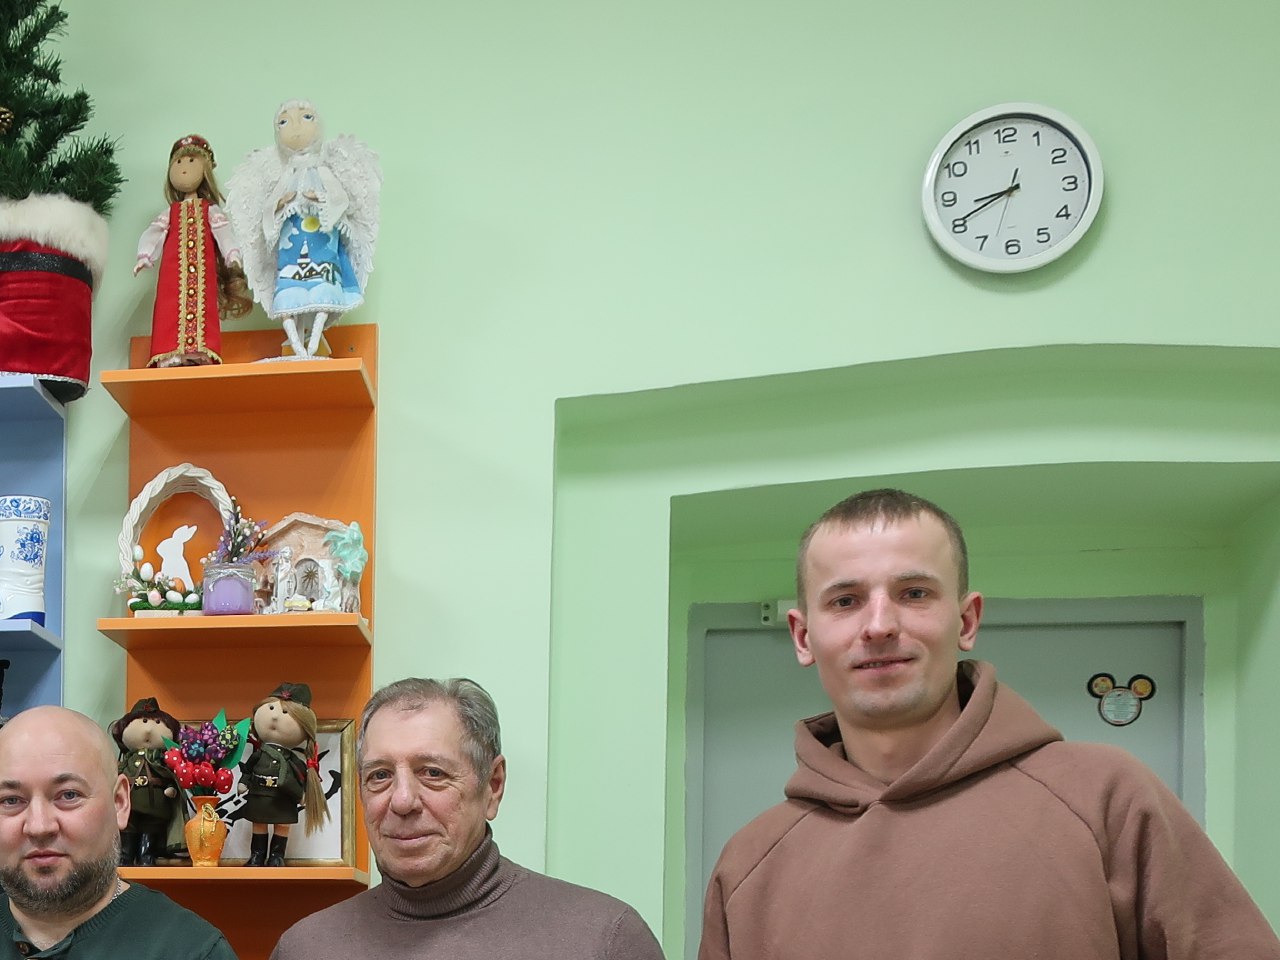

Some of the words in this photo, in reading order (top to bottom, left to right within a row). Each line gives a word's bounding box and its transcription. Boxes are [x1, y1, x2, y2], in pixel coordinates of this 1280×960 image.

[993, 126, 1018, 144] 12
[1032, 130, 1041, 147] 1
[964, 139, 980, 155] 11
[1050, 147, 1068, 165] 2
[943, 161, 968, 178] 10
[1061, 175, 1079, 192] 3
[941, 190, 958, 208] 9
[1055, 204, 1072, 220] 4
[951, 217, 968, 234] 8
[974, 235, 989, 251] 7
[1036, 227, 1051, 244] 5
[1004, 239, 1021, 255] 6
